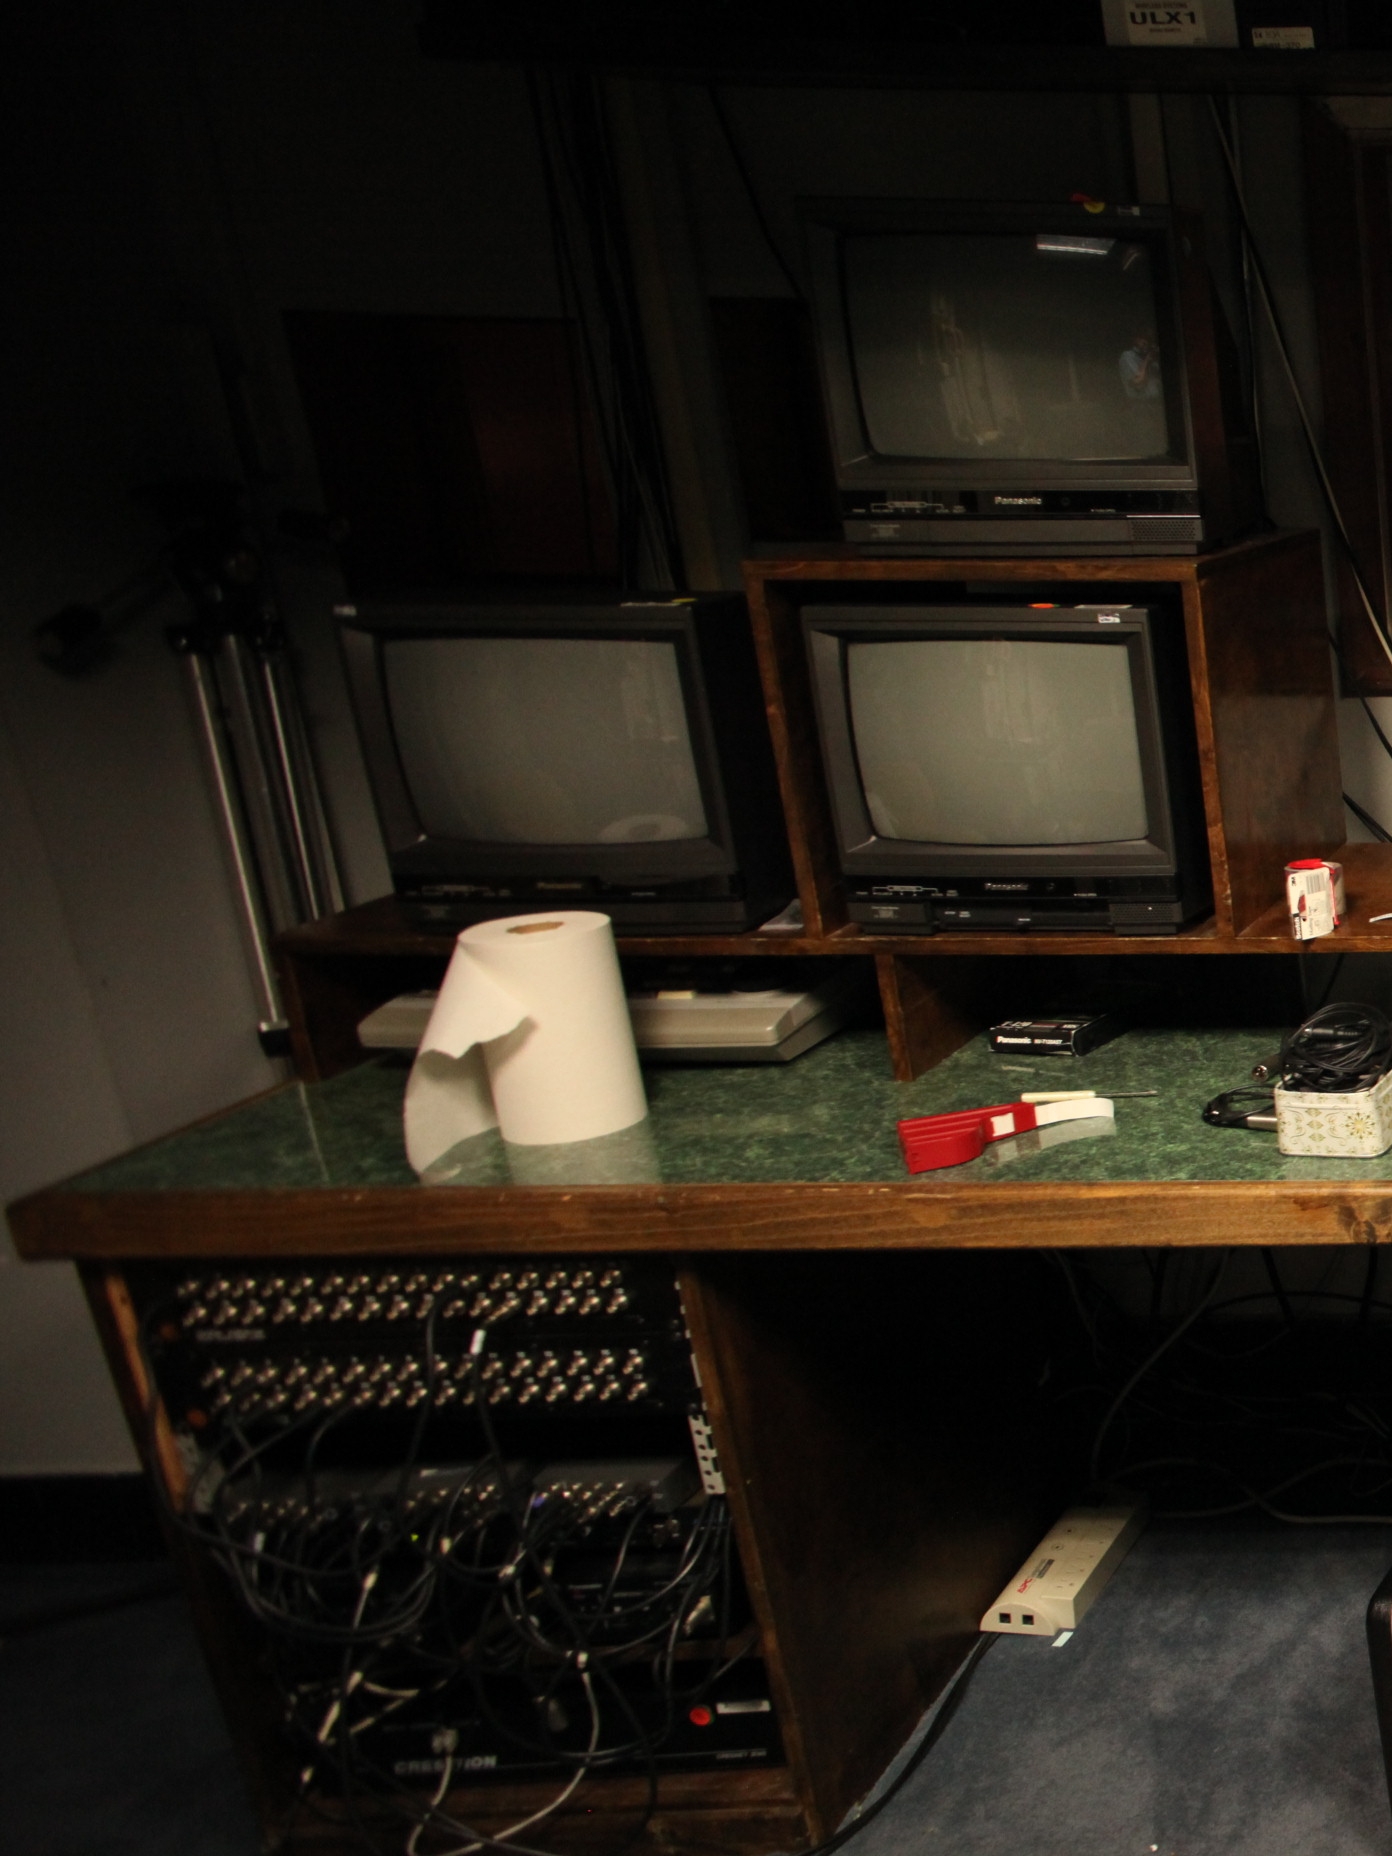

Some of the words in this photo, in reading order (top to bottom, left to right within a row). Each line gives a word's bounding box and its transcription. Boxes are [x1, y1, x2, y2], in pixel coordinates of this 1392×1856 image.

[1130, 11, 1196, 25] ULX1
[994, 496, 1042, 505] Panasonic
[996, 1035, 1032, 1044] Panasonic
